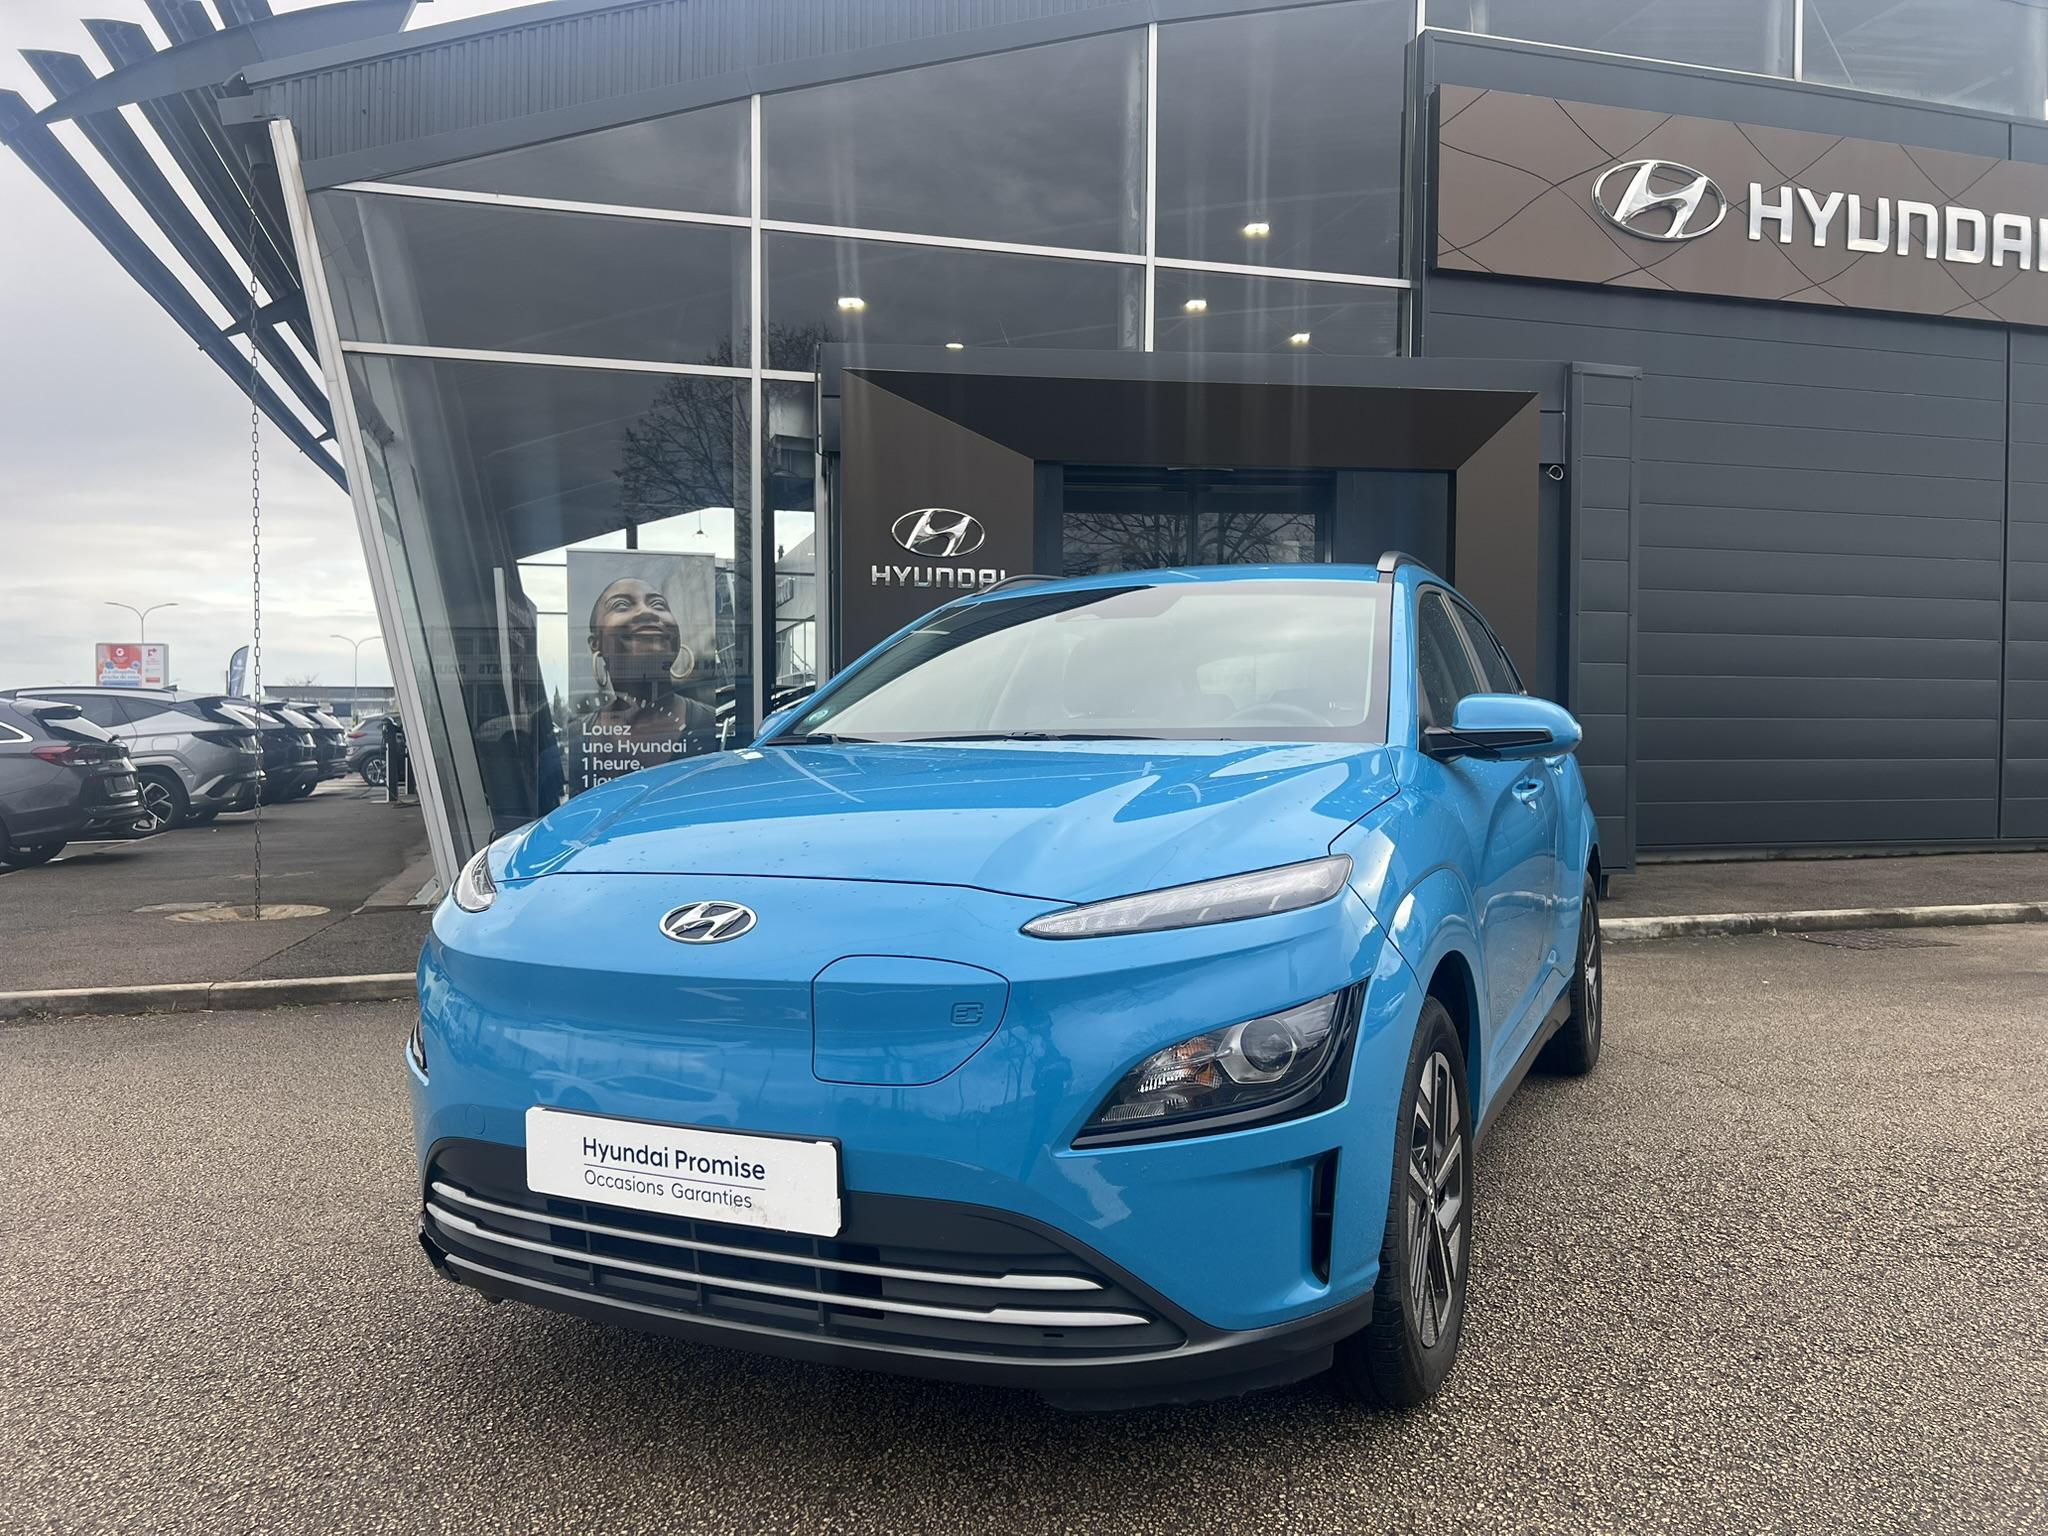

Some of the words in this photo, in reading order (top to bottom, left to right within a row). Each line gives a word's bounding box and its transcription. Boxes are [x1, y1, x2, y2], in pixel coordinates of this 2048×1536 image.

[1748, 182, 2048, 272] HYUNDAI
[582, 722, 632, 736] Louez
[582, 742, 614, 753] une
[617, 739, 687, 756] Hyundai
[581, 757, 590, 771] 1
[581, 774, 590, 788] 1
[593, 773, 613, 789] jo
[583, 1136, 669, 1168] Hyundai
[675, 1150, 766, 1180] Promise
[584, 1169, 665, 1196] Occasions
[671, 1182, 753, 1209] Garanties
